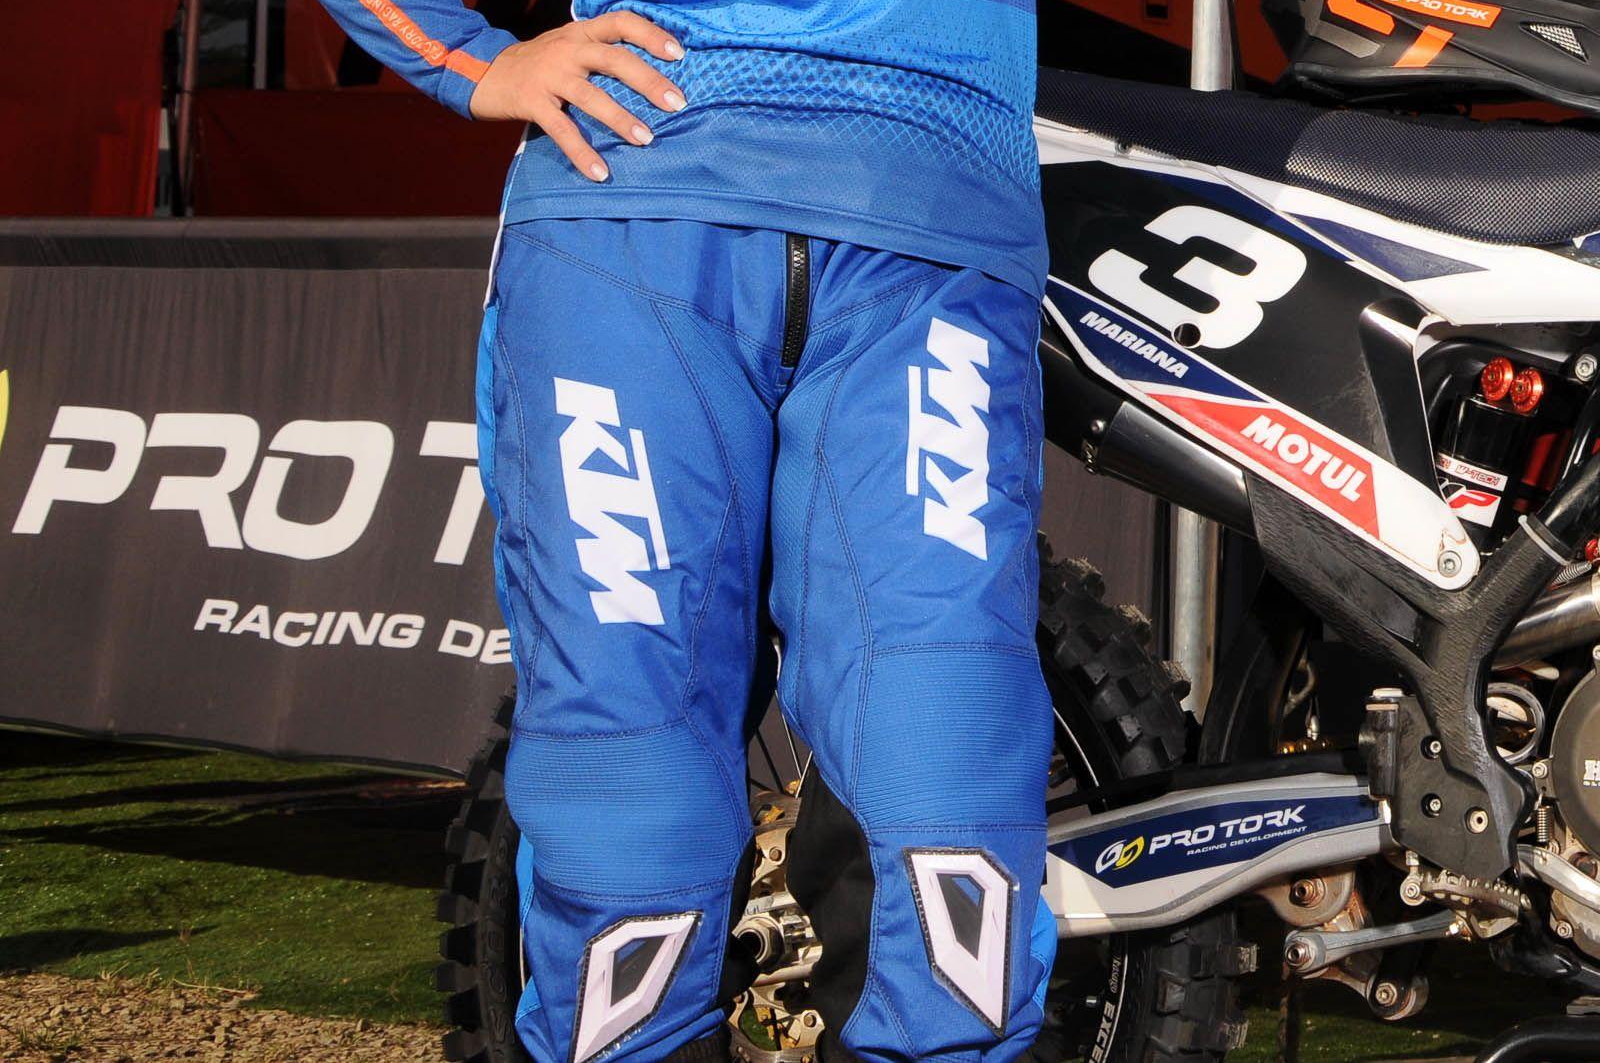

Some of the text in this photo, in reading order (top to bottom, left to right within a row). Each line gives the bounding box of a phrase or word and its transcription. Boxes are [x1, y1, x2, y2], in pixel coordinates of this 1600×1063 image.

[1088, 205, 1307, 349] 3
[1081, 311, 1189, 378] MARIANA
[906, 318, 989, 561] KTM
[1240, 414, 1368, 502] MOTUL
[11, 405, 394, 560] PRO
[553, 377, 670, 626] KTM
[194, 599, 424, 648] RACING
[1149, 804, 1305, 855] PRO TORK
[1186, 825, 1308, 856] RACING DEVELOPMENT
[1088, 1001, 1115, 1063] EXCE
